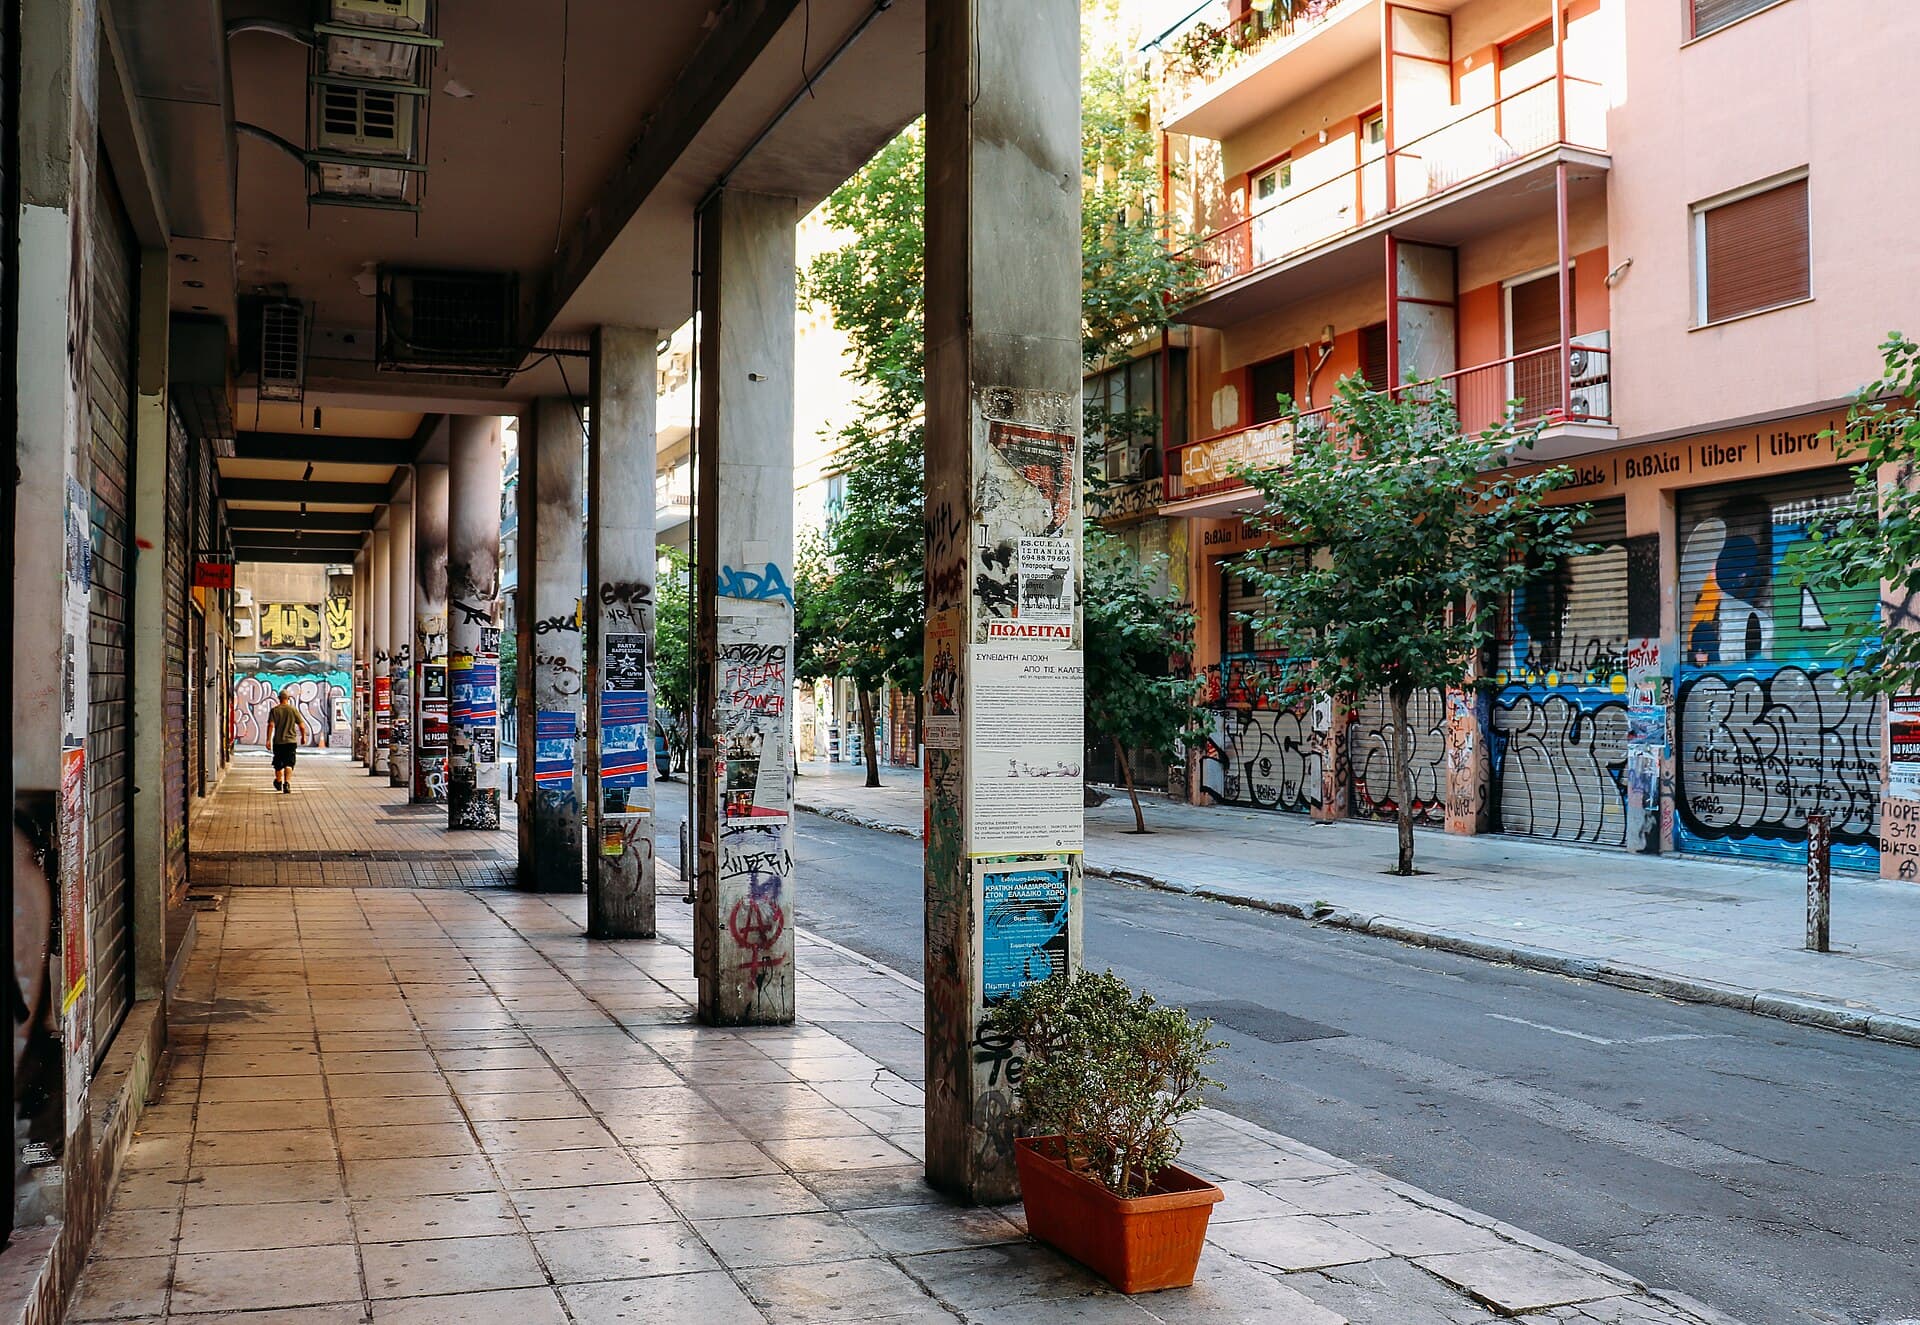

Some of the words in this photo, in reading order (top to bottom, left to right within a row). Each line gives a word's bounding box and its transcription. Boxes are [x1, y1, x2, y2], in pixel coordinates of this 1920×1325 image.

[1770, 432, 1820, 457] libro
[1701, 443, 1748, 468] liber
[990, 624, 1071, 638] ΠΩΛΕΙΤΑΙ
[976, 653, 1019, 662] ΣΥΝΕΙΔΗΤΗ
[1021, 654, 1049, 662] ΑΠΟΧΗ
[1023, 665, 1041, 673] ΑΠΟ
[1044, 666, 1057, 674] ΤΙΣ
[985, 884, 1013, 892] ΚΡΑΤΙΚΗ
[985, 891, 1004, 899] ΣΤΟΝ
[1007, 890, 1042, 898] ΕΛΛΑΔΙΚΟ
[1045, 889, 1065, 897] ΧΩΡΟ
